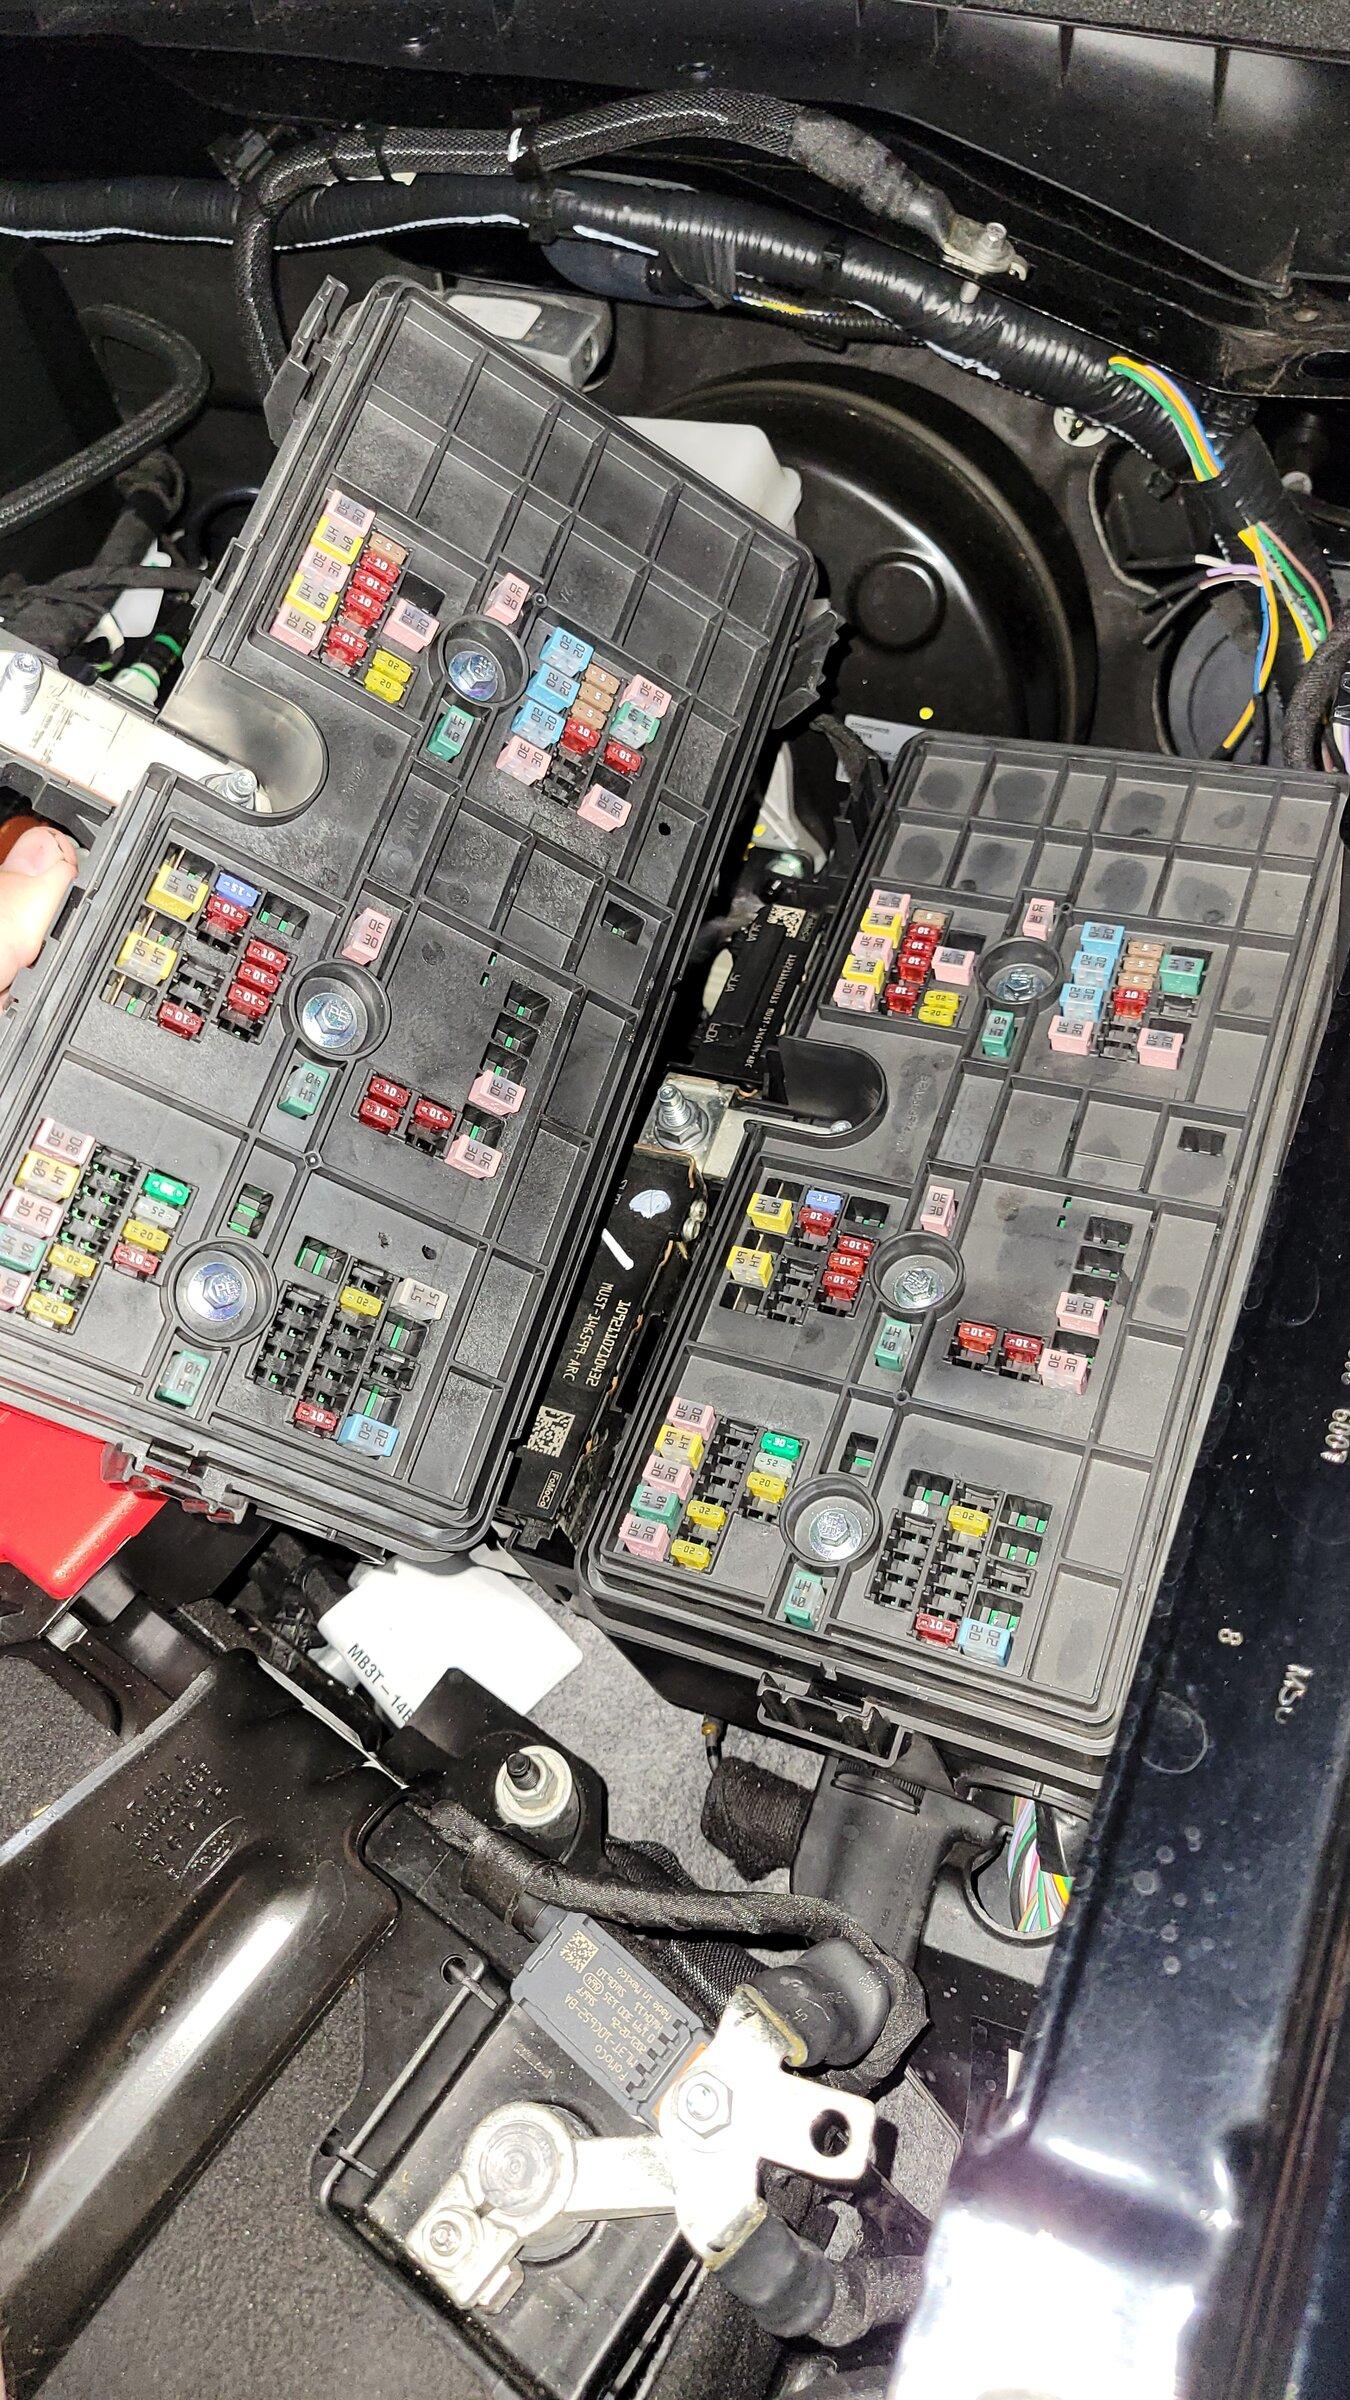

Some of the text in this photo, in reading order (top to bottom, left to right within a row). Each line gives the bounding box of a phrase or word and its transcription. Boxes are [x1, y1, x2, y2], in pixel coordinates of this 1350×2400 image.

[336, 499, 350, 515] 30
[352, 509, 365, 525] 30
[325, 526, 339, 543] HT
[340, 535, 354, 552] 60
[313, 552, 326, 568] 30
[374, 558, 388, 570] 10
[329, 561, 342, 577] 30
[366, 578, 380, 589] 10
[509, 582, 523, 598] 30
[300, 583, 313, 599] HT
[314, 594, 328, 610] 60
[358, 595, 372, 607] 10
[504, 595, 518, 611] 30
[287, 612, 301, 628] 30
[402, 610, 415, 625] 30
[302, 621, 316, 636] 30
[417, 618, 430, 635] 30
[341, 633, 355, 646] 10
[560, 634, 572, 650] 20
[573, 643, 586, 659] 20
[387, 659, 400, 670] 20
[379, 678, 392, 688] 20
[546, 672, 559, 688] 20
[599, 673, 606, 682] 5
[560, 680, 572, 696] 20
[640, 681, 651, 696] 30
[594, 692, 601, 700] 5
[652, 690, 665, 705] 30
[531, 707, 544, 723] 20
[587, 709, 593, 718] 5
[451, 714, 466, 728] HT
[545, 715, 557, 731] 20
[578, 725, 591, 738] 10
[517, 743, 530, 760] 30
[619, 750, 632, 762] 10
[530, 751, 544, 767] 30
[598, 792, 610, 808] 30
[611, 801, 624, 817] 30
[166, 875, 181, 893] HT
[230, 882, 243, 892] 15
[222, 906, 236, 916] 10
[368, 918, 385, 934] 30
[134, 940, 149, 956] 60
[363, 933, 379, 949] 30
[151, 949, 166, 965] HT
[261, 949, 275, 960] 10
[253, 973, 266, 983] 10
[243, 993, 256, 1004] 10
[175, 1012, 189, 1023] 10
[298, 1086, 315, 1099] HT
[383, 1086, 396, 1096] 10
[489, 1082, 502, 1097] 30
[504, 1087, 518, 1104] 30
[374, 1108, 388, 1119] 10
[429, 1108, 442, 1120] 10
[464, 1145, 478, 1161] 30
[480, 1151, 493, 1168] 30
[357, 1296, 369, 1306] 20
[1066, 1298, 1078, 1311] 30
[1081, 1302, 1094, 1316] 30
[971, 1328, 984, 1336] 10
[1016, 1339, 1028, 1347] 10
[1048, 1353, 1061, 1368] 30
[1064, 1357, 1077, 1371] 30
[310, 1411, 324, 1421] 10
[676, 1404, 689, 1418] 30
[690, 1408, 703, 1422] 30
[359, 1422, 372, 1440] 20
[664, 1431, 676, 1445] 60
[374, 1430, 388, 1447] 20
[678, 1437, 691, 1450] HT
[652, 1462, 664, 1476] 30
[666, 1467, 679, 1481] 30
[539, 1471, 560, 1506] FoMoCo
[759, 1478, 771, 1487] 20
[642, 1492, 652, 1505] HT
[656, 1496, 668, 1509] 40
[628, 1522, 641, 1536] 30
[642, 1526, 656, 1540] 30
[794, 1582, 811, 1592] HT
[930, 1621, 943, 1629] 10
[969, 1626, 983, 1640] 20
[986, 1630, 999, 1646] 20
[346, 1642, 384, 1685] MB3T
[614, 1965, 673, 2022] Made in Mexico
[591, 2043, 630, 2081] FoMoCo
